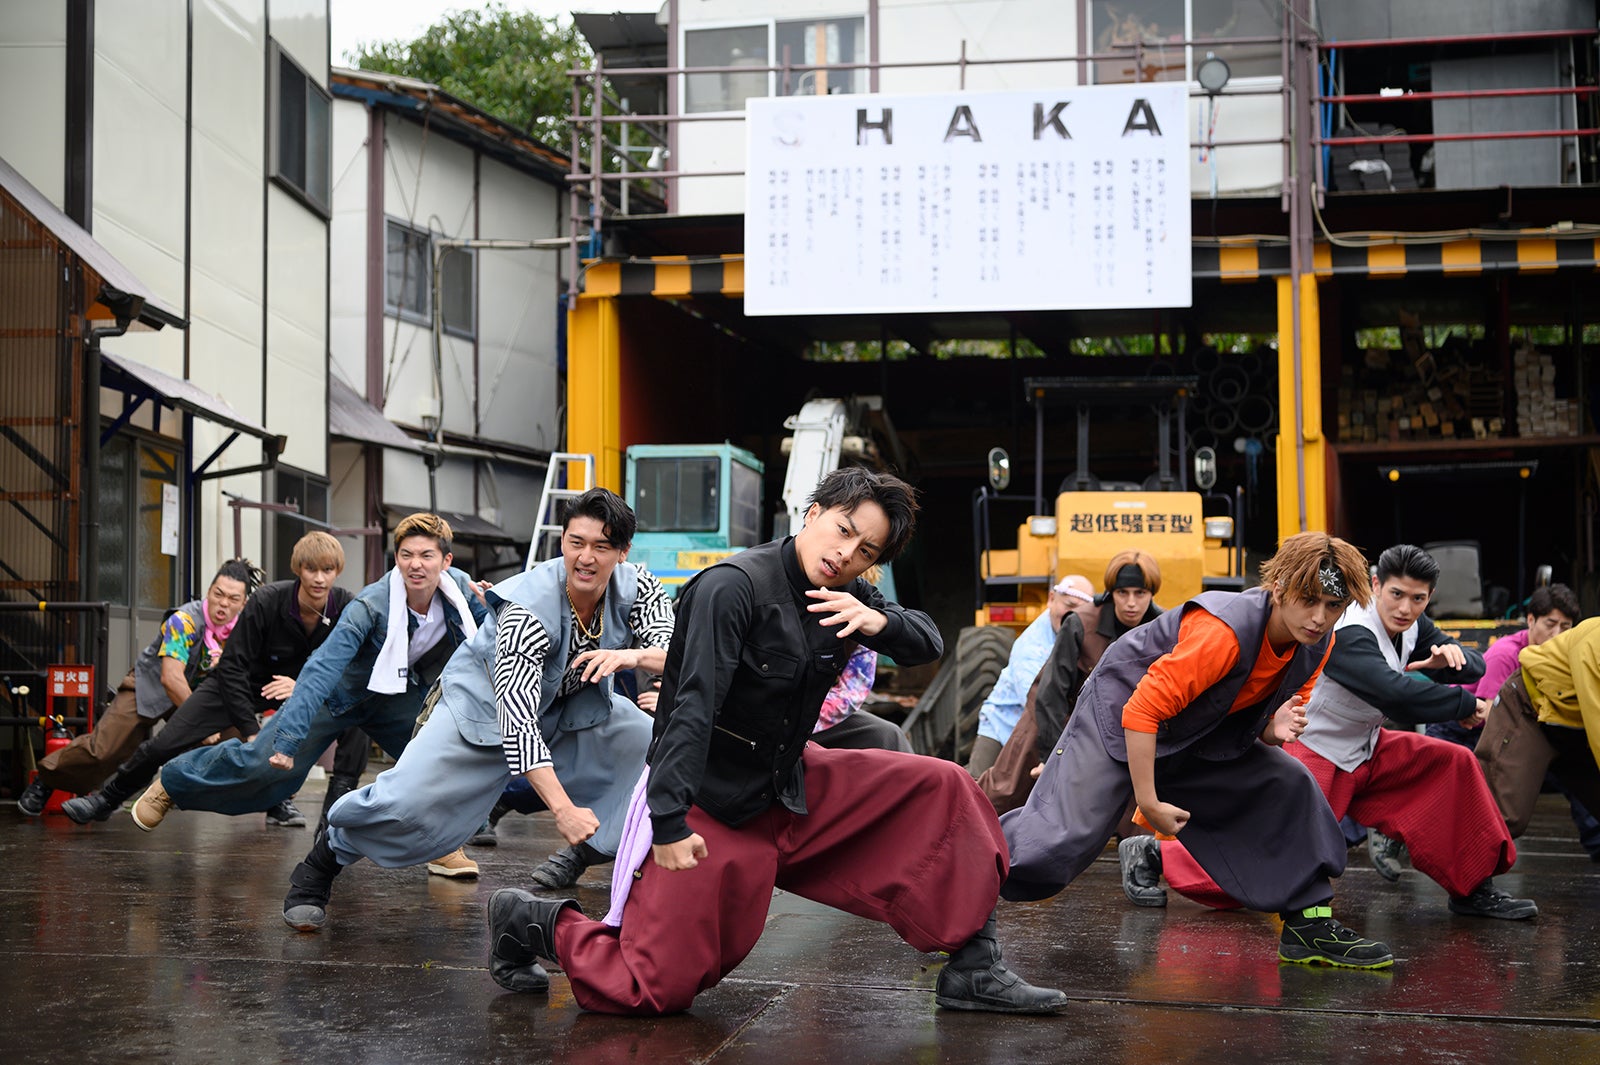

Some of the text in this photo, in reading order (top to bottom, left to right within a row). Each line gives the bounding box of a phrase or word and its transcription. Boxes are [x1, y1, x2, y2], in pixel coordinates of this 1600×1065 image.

[1070, 513, 1193, 534] 超低騒音型
[54, 671, 89, 683] 消火器
